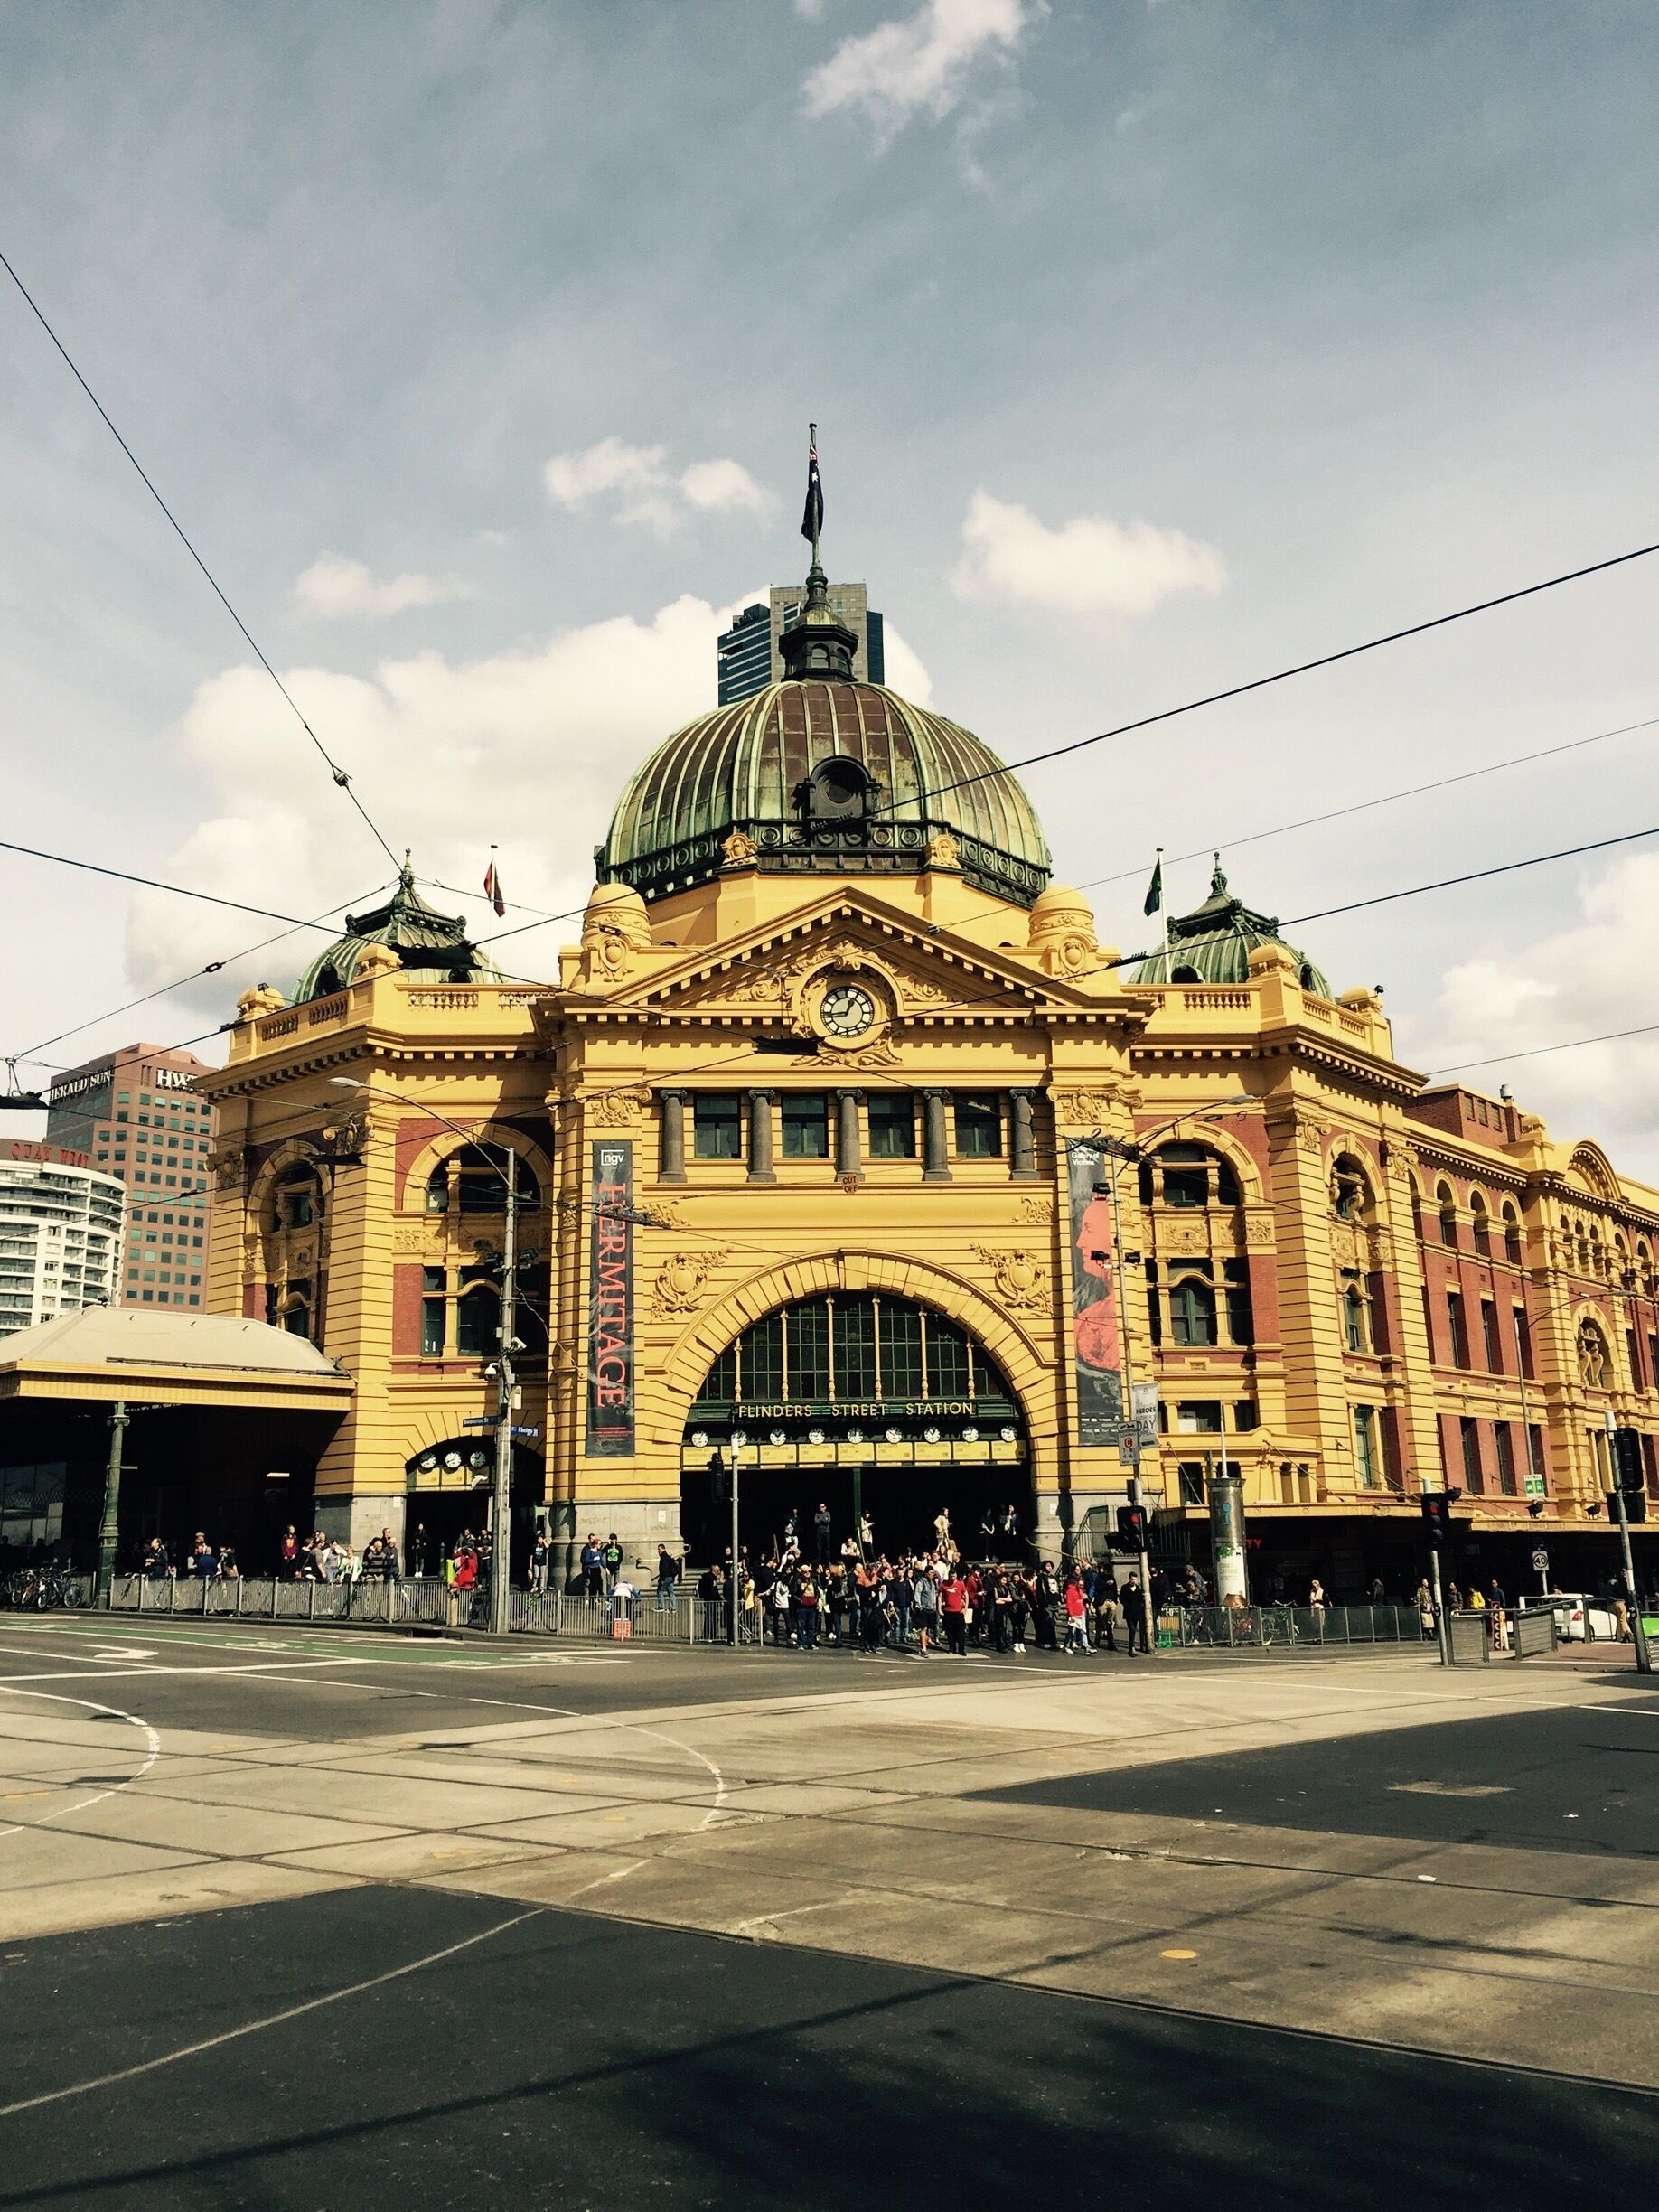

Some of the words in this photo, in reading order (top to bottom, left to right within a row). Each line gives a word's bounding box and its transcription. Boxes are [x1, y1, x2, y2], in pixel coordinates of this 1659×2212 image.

[49, 1077, 88, 1101] HERALD
[89, 1069, 112, 1088] SUN
[603, 1152, 624, 1167] ngv
[596, 1182, 627, 1408] HERMITAGE
[738, 1404, 812, 1418] FLINDERS
[831, 1403, 888, 1417] STREET
[905, 1401, 974, 1415] STATION
[1136, 1406, 1157, 1414] HEROES
[1137, 1417, 1157, 1431] DAY
